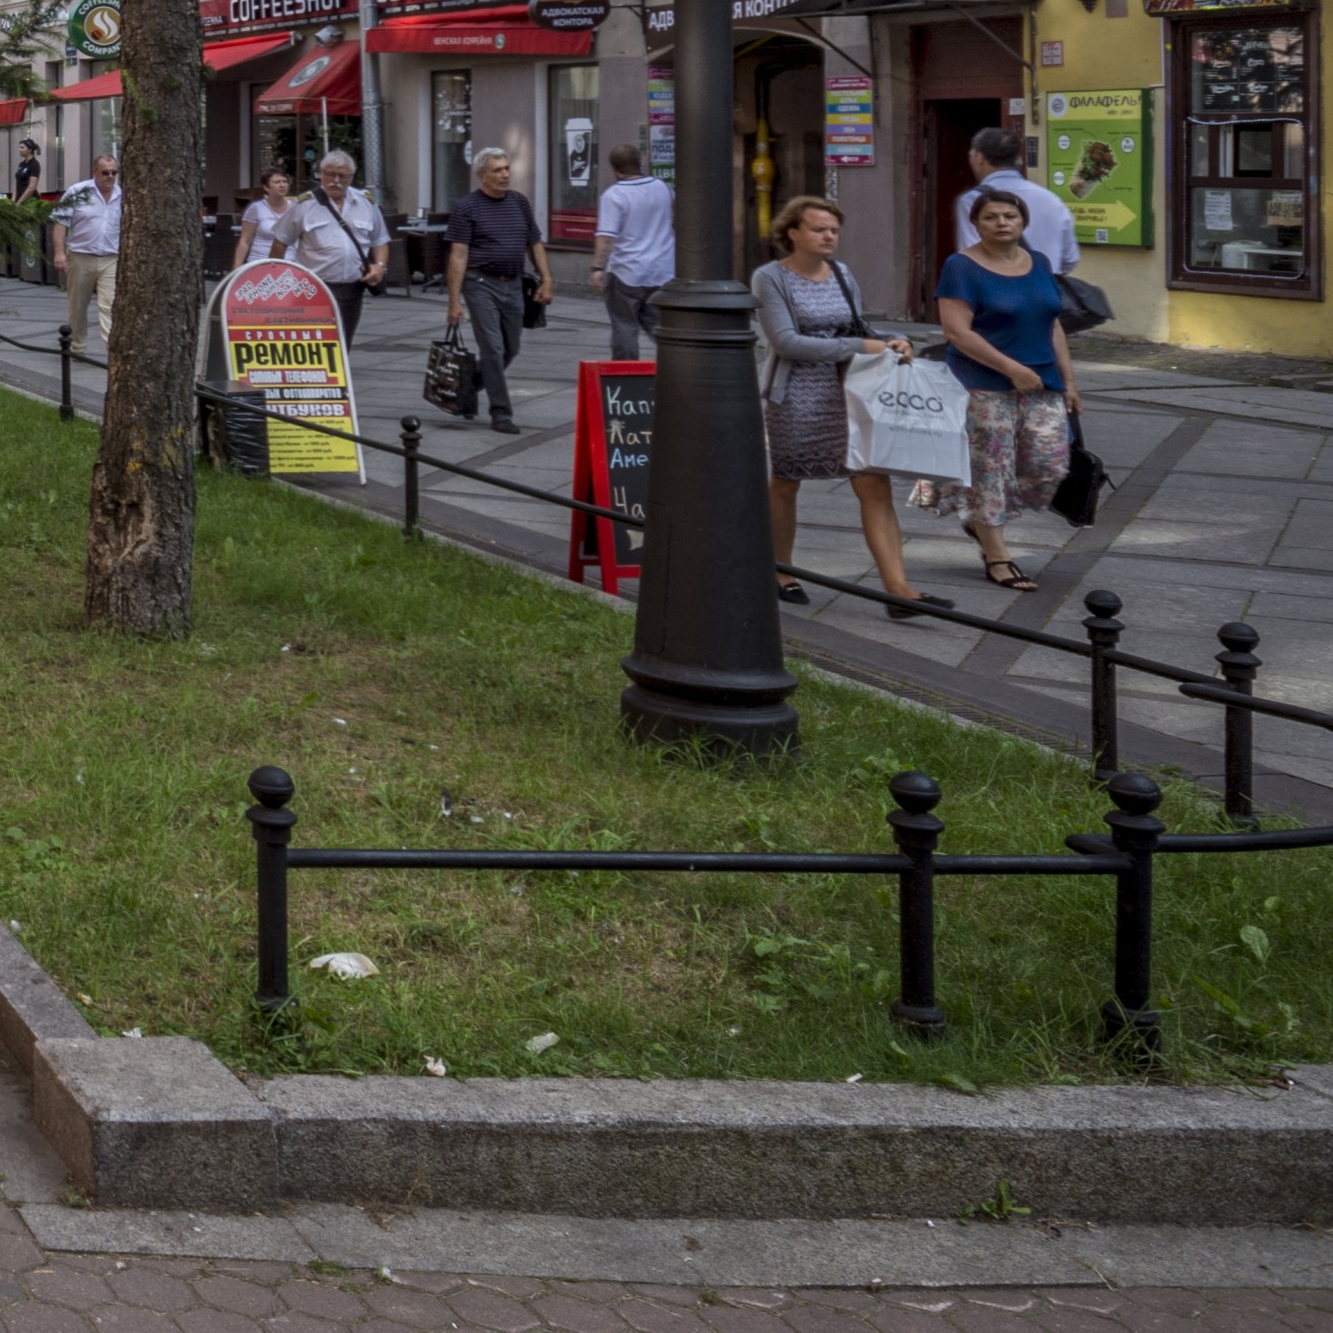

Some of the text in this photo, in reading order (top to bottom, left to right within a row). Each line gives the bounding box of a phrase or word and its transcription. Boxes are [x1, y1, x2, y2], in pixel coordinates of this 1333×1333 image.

[541, 7, 604, 16] АДВОКАТСКАЯ
[552, 18, 593, 27] КОНТОРА
[653, 168, 675, 180] ЦВЕ
[245, 329, 323, 341] СРОЧНЫЙ
[284, 370, 328, 383] ТЕЛЕФОНОВ
[283, 388, 342, 398] ФОТОАППАРАТОВ
[606, 385, 655, 415] Кап
[878, 391, 944, 413] ecco
[608, 424, 653, 445] Лат
[610, 448, 649, 469] Аме
[614, 485, 645, 518] Ча
